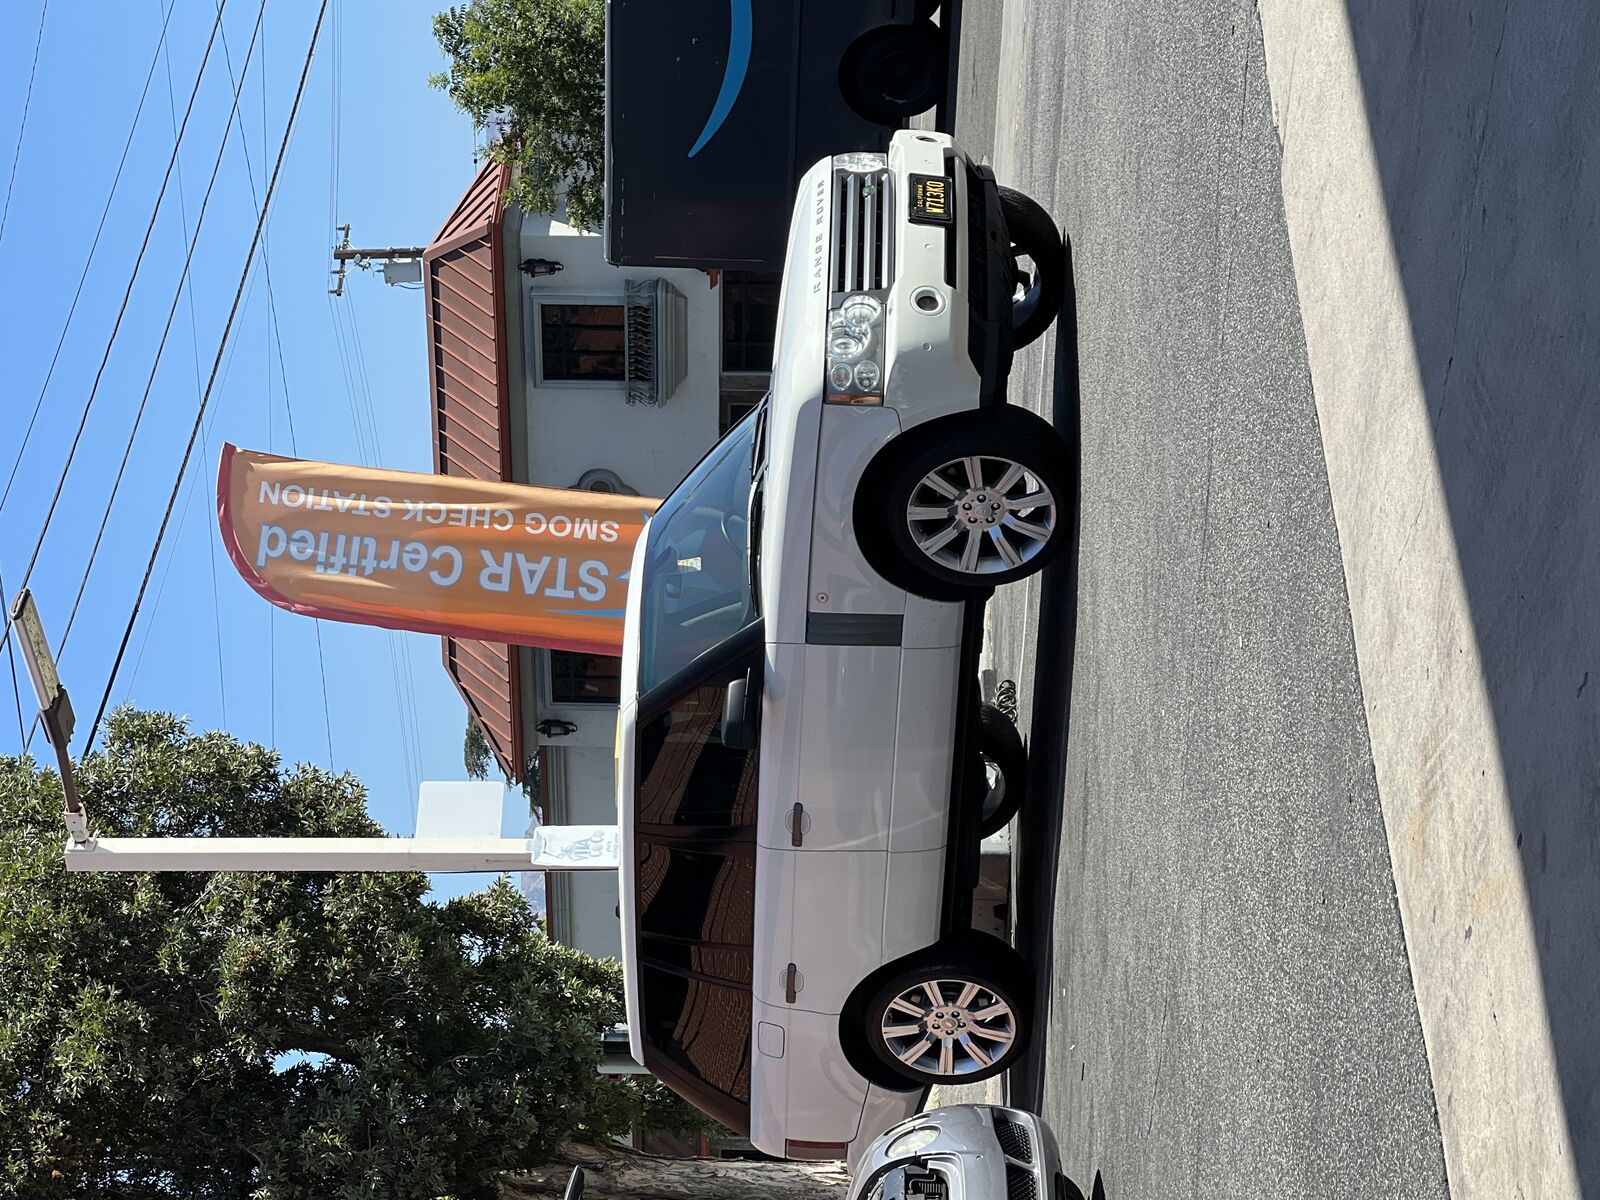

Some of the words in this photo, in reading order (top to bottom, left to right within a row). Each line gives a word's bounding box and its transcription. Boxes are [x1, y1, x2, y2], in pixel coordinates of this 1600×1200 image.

[815, 179, 824, 226] ROVER
[812, 233, 822, 294] RANGE
[258, 480, 393, 519] STATION
[402, 498, 515, 530] CHECK
[525, 512, 620, 543] SMOG
[256, 524, 464, 587] Certified
[480, 548, 609, 602] STAR
